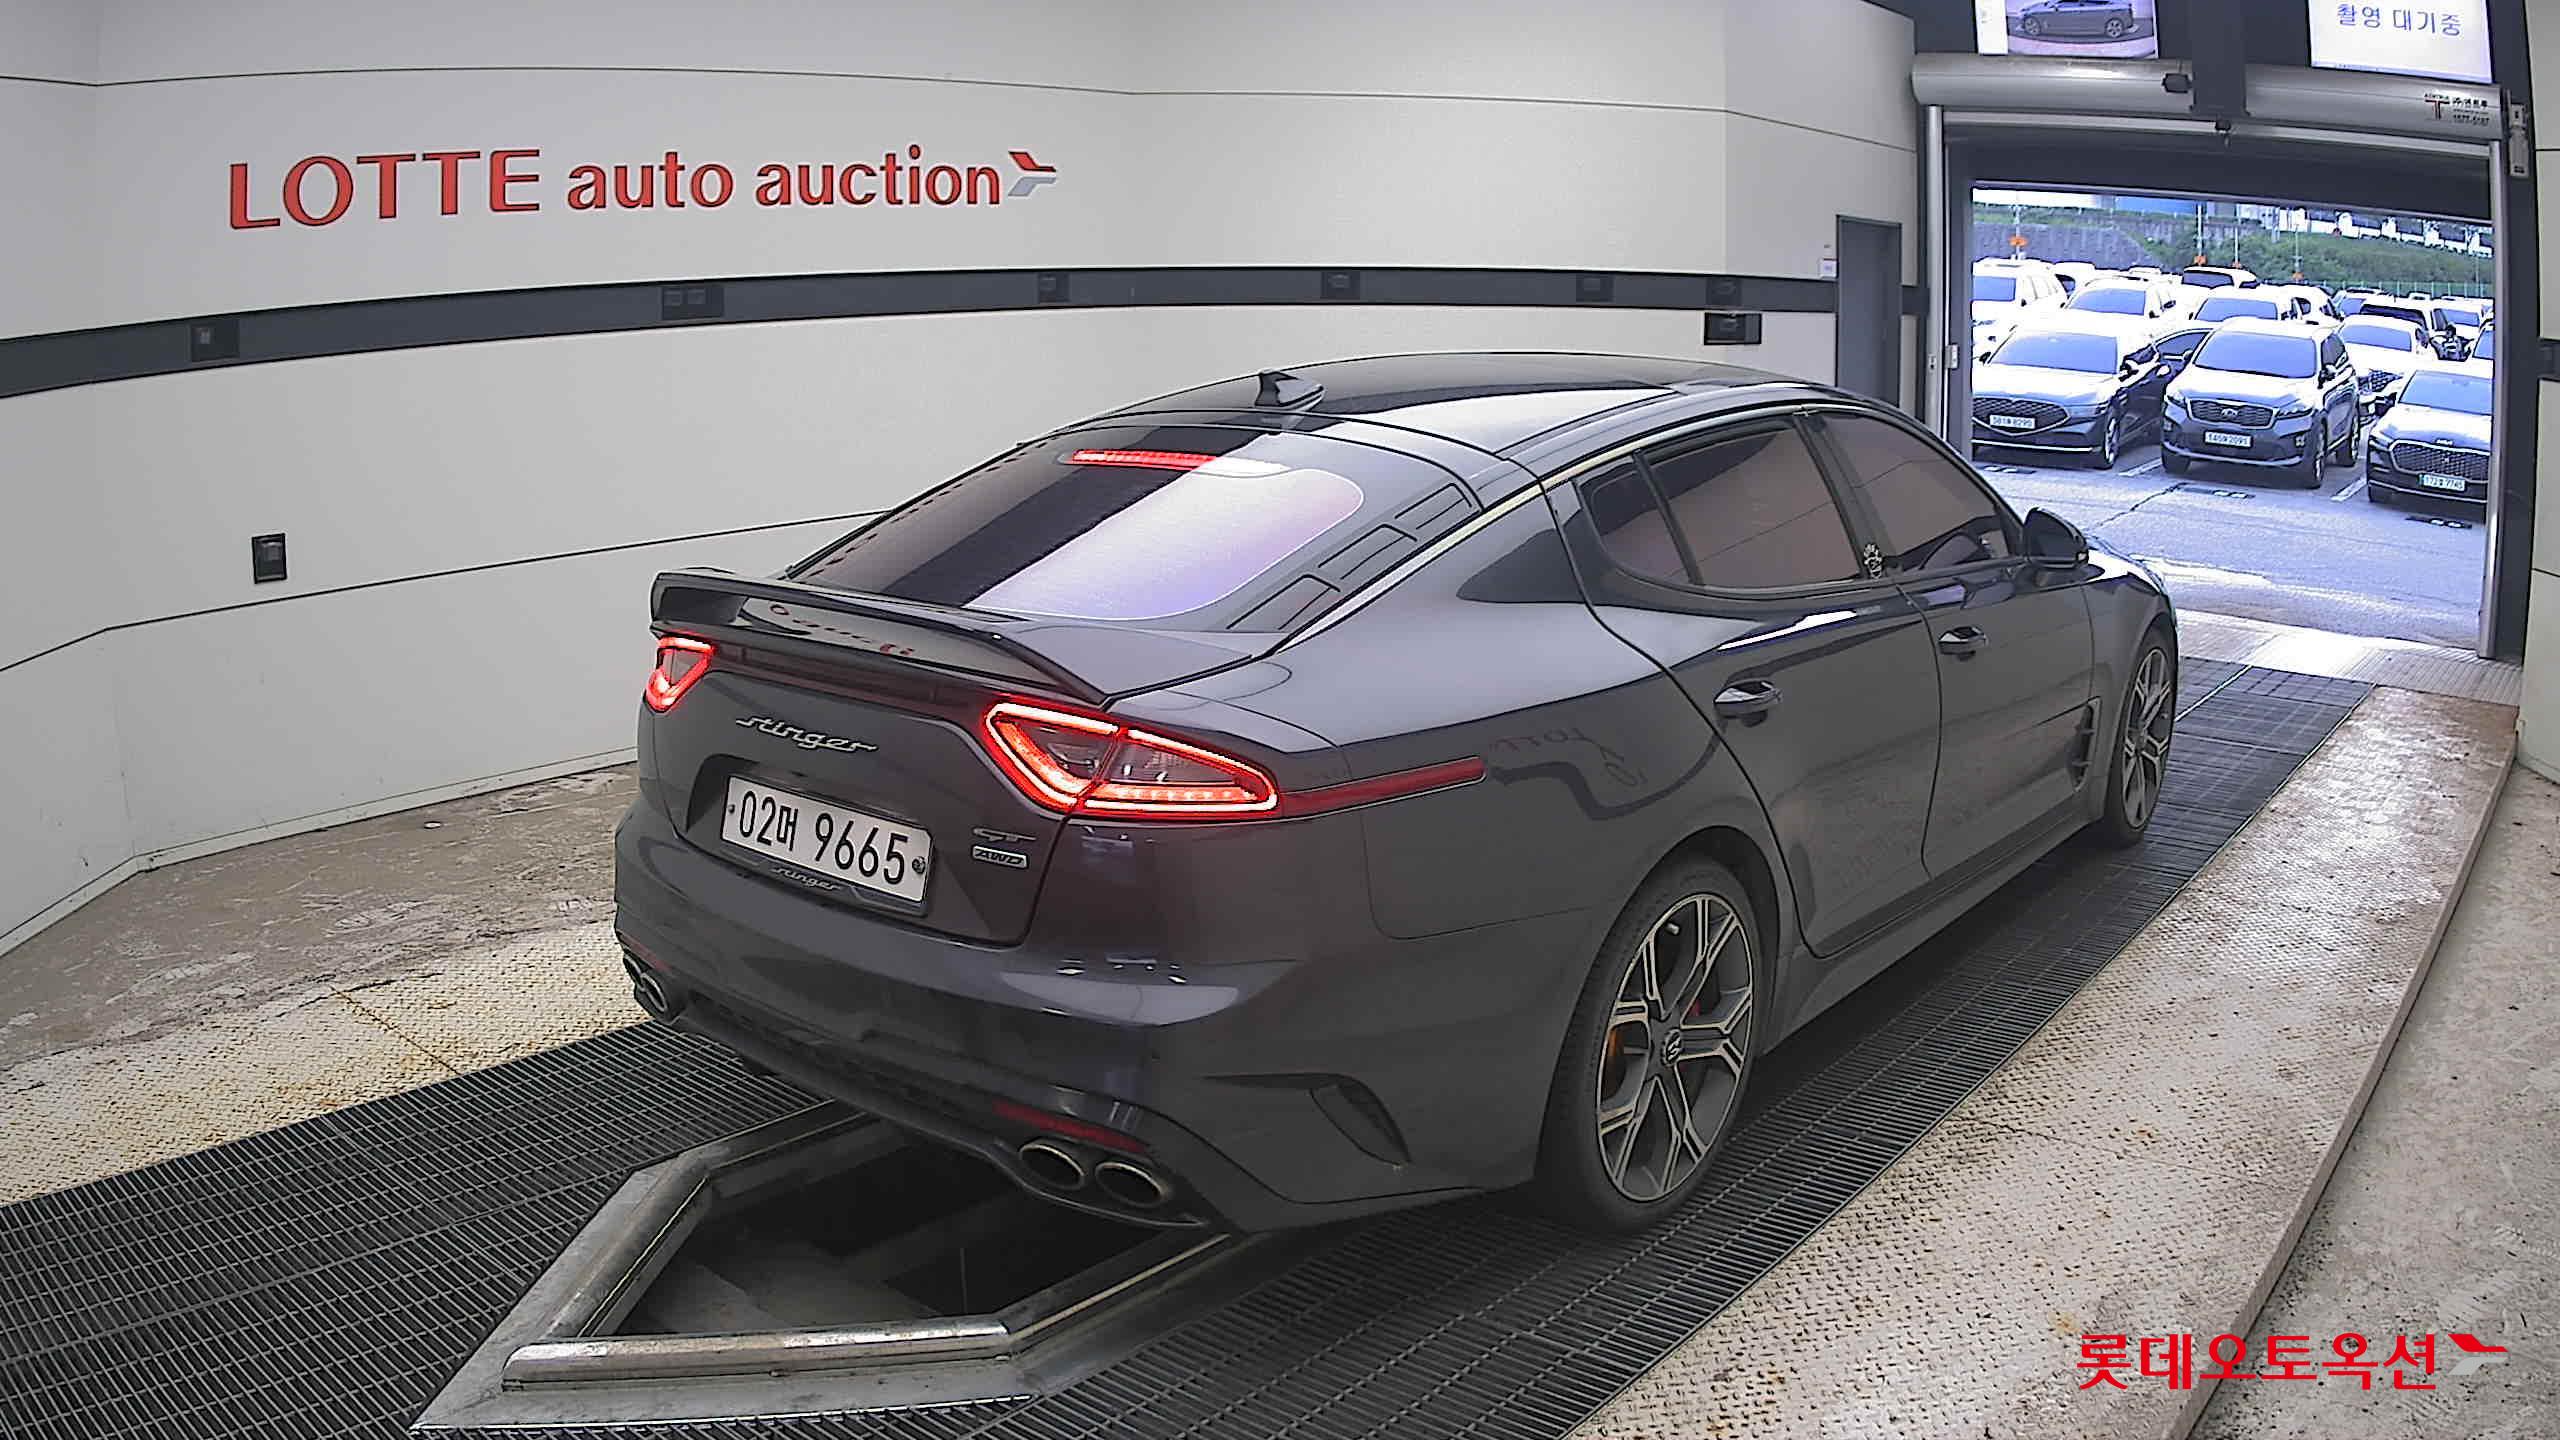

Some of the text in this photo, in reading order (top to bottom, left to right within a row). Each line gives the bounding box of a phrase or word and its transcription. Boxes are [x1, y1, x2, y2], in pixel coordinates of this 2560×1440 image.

[2393, 8, 2460, 36] 대기중
[229, 144, 1001, 230] LOTTE auto auction
[739, 790, 909, 885] 02머 9665
